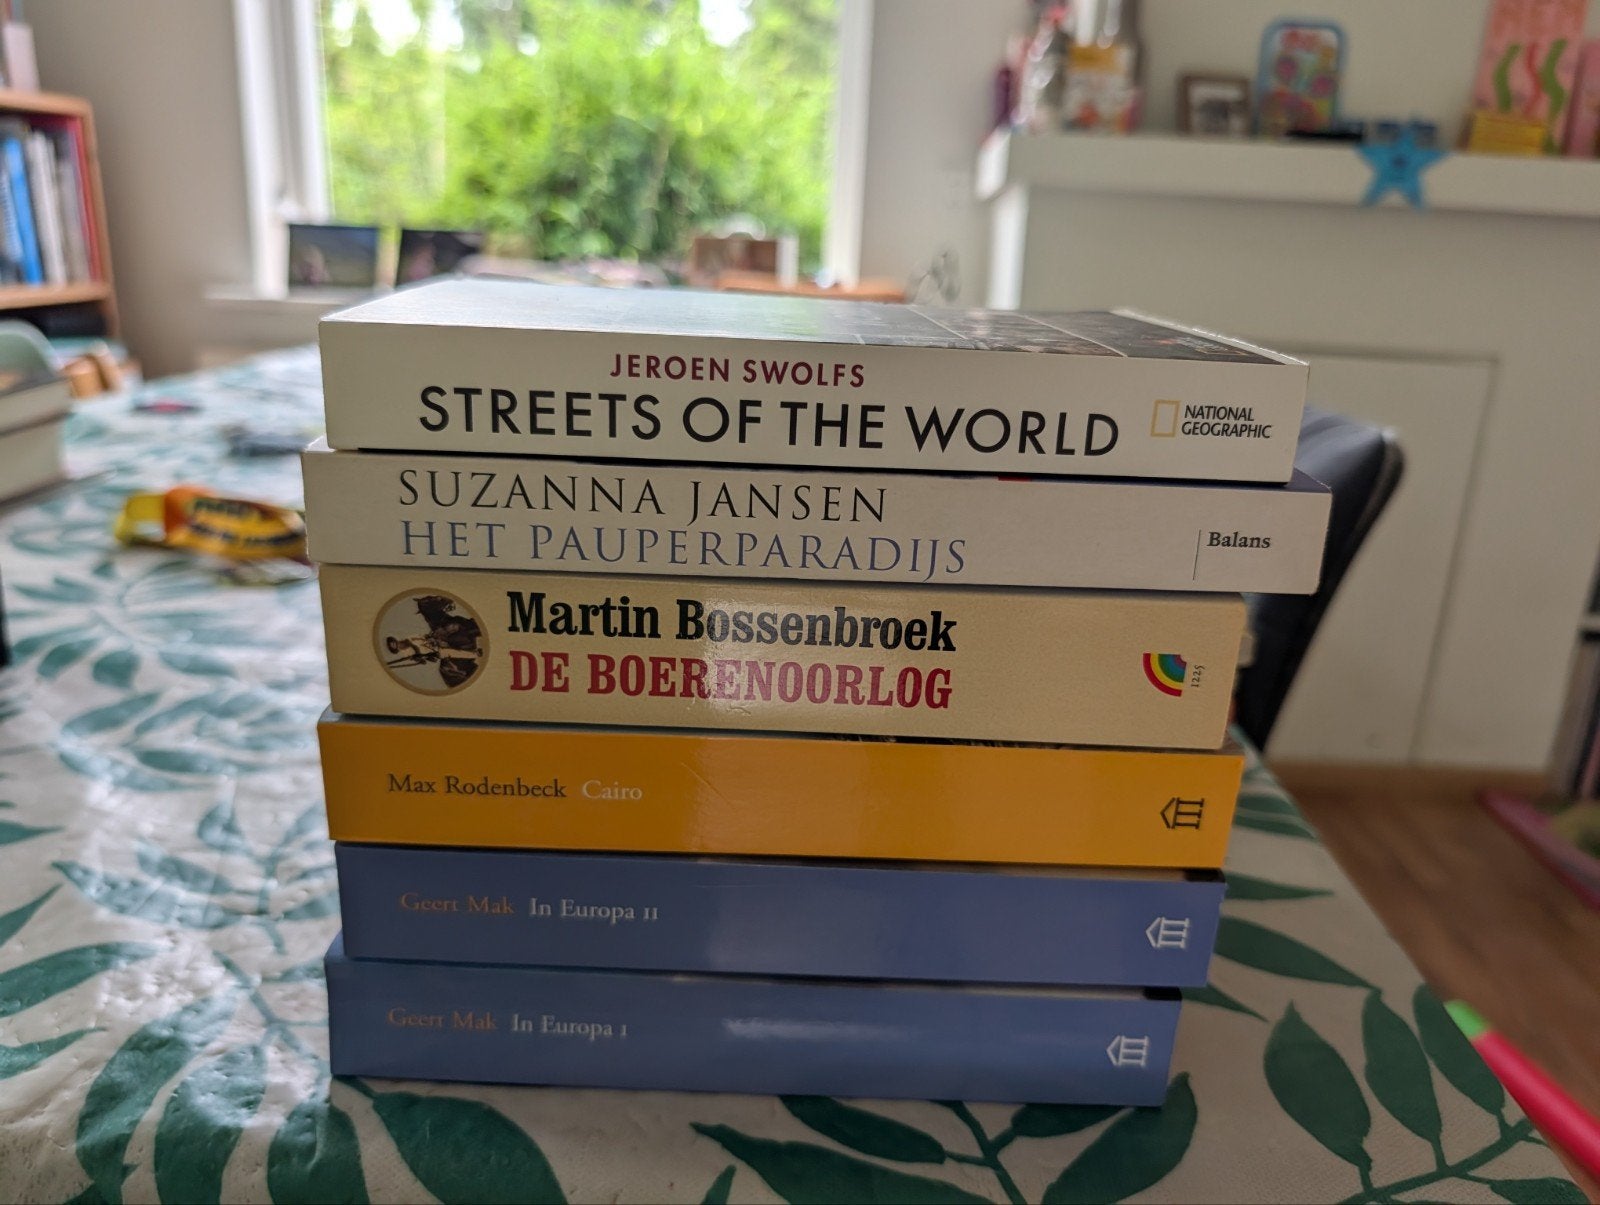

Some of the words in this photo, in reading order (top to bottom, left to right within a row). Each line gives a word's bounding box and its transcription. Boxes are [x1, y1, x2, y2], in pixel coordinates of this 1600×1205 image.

[610, 353, 729, 383] JEROEN
[743, 358, 866, 389] SWOLFS
[419, 386, 661, 441] STREETS
[682, 396, 762, 445] OF
[780, 400, 886, 450] THE
[904, 405, 1120, 456] WORLD
[1181, 421, 1272, 439] GEOGRAPHIC
[1184, 405, 1255, 422] NATIONAL
[399, 469, 665, 515] SUZANNA
[687, 480, 886, 526] JANSEN
[402, 519, 506, 557] HET
[530, 524, 966, 583] PAUPERPARADIJS
[1207, 530, 1271, 551] Balans
[506, 590, 661, 640] Martin
[676, 598, 957, 652] Bossenbroek
[509, 650, 570, 693] DE
[587, 654, 953, 710] BOERENOORLOG
[1190, 664, 1206, 688] 1225
[388, 773, 436, 795] Max
[444, 774, 567, 799] Rodenbeck
[581, 779, 643, 801] Cairo
[400, 892, 460, 914] Geert
[466, 894, 514, 916] Mak
[529, 898, 553, 916] In
[559, 900, 636, 924] Europa
[387, 1006, 444, 1028] Geert
[452, 1010, 498, 1032] Mak
[511, 1013, 534, 1031] In
[540, 1014, 615, 1041] Europa
